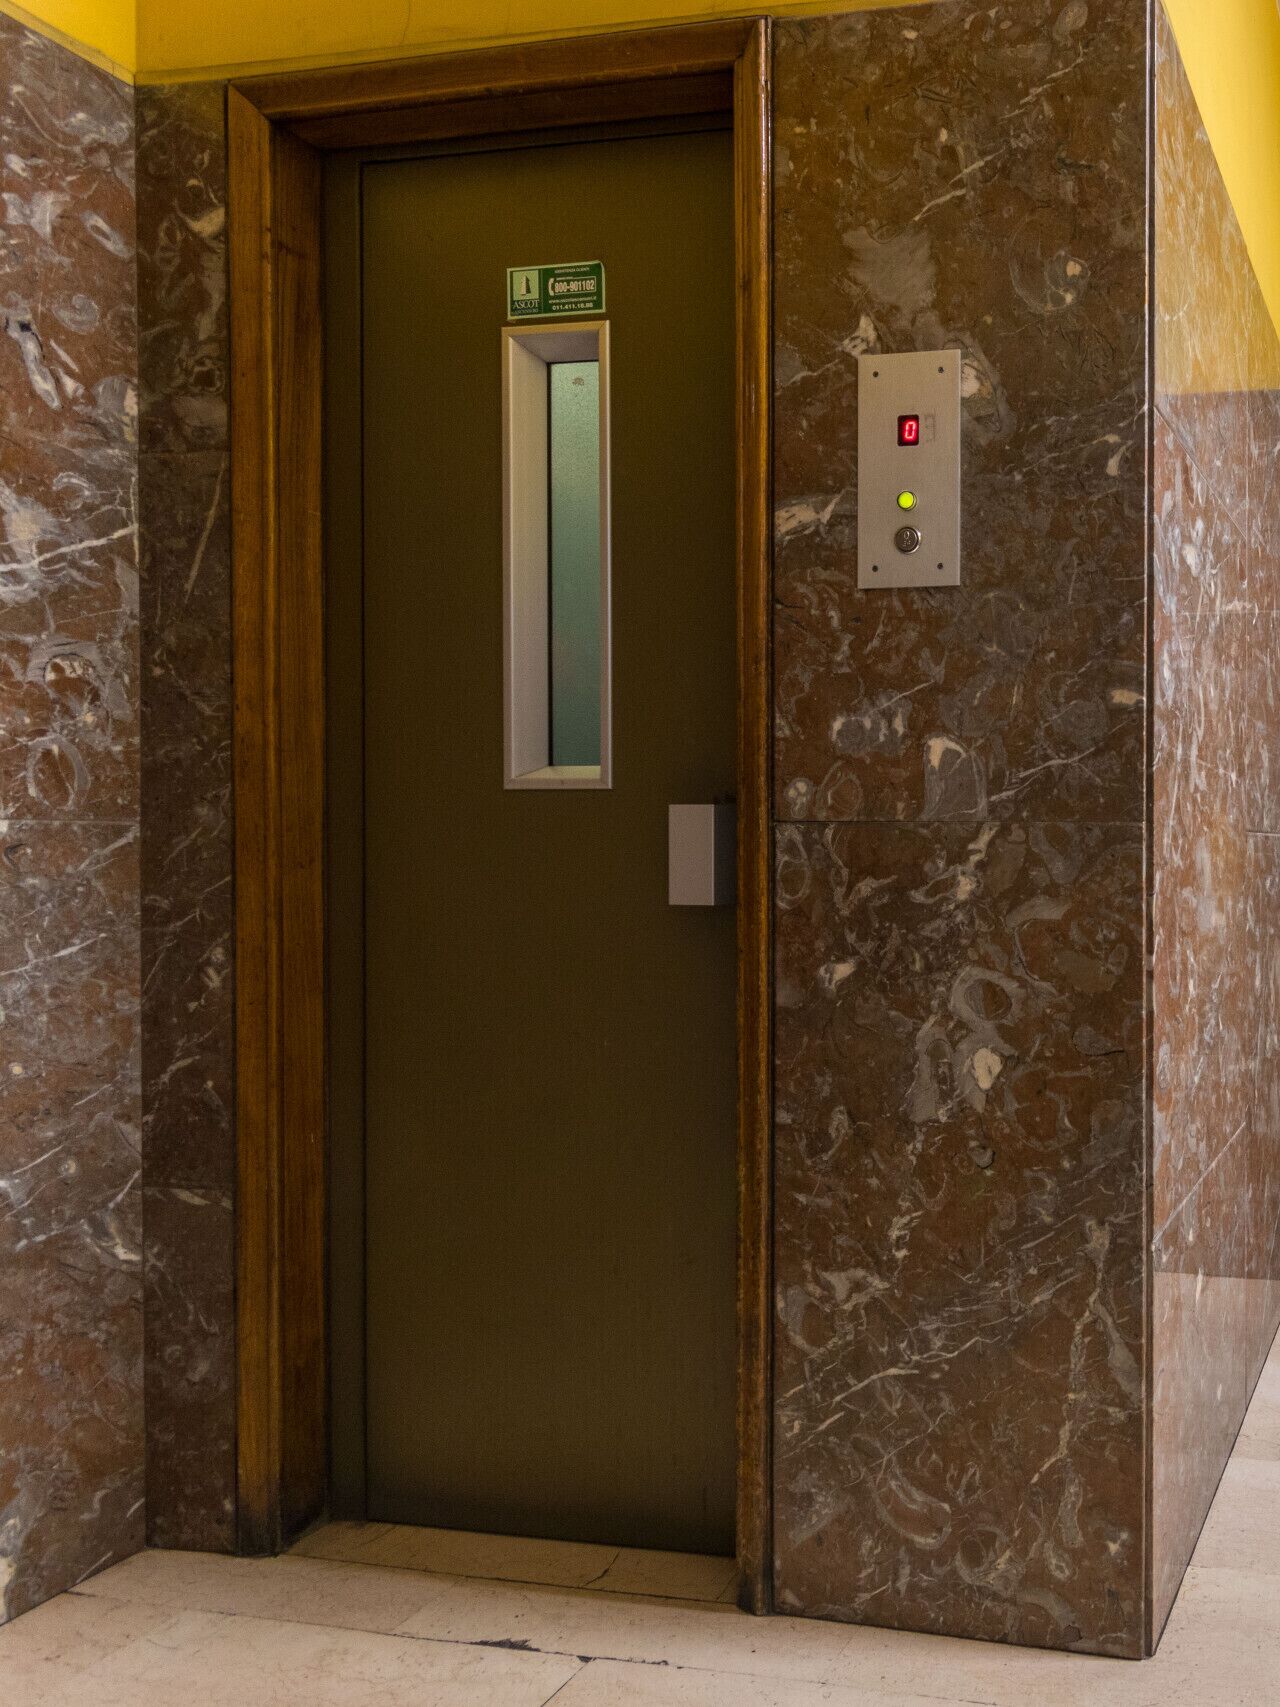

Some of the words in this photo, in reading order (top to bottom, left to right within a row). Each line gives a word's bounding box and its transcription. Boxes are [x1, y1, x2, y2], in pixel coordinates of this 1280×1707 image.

[554, 279, 595, 293] 800-901102
[512, 299, 540, 309] ASCOT
[905, 421, 916, 439] 0
